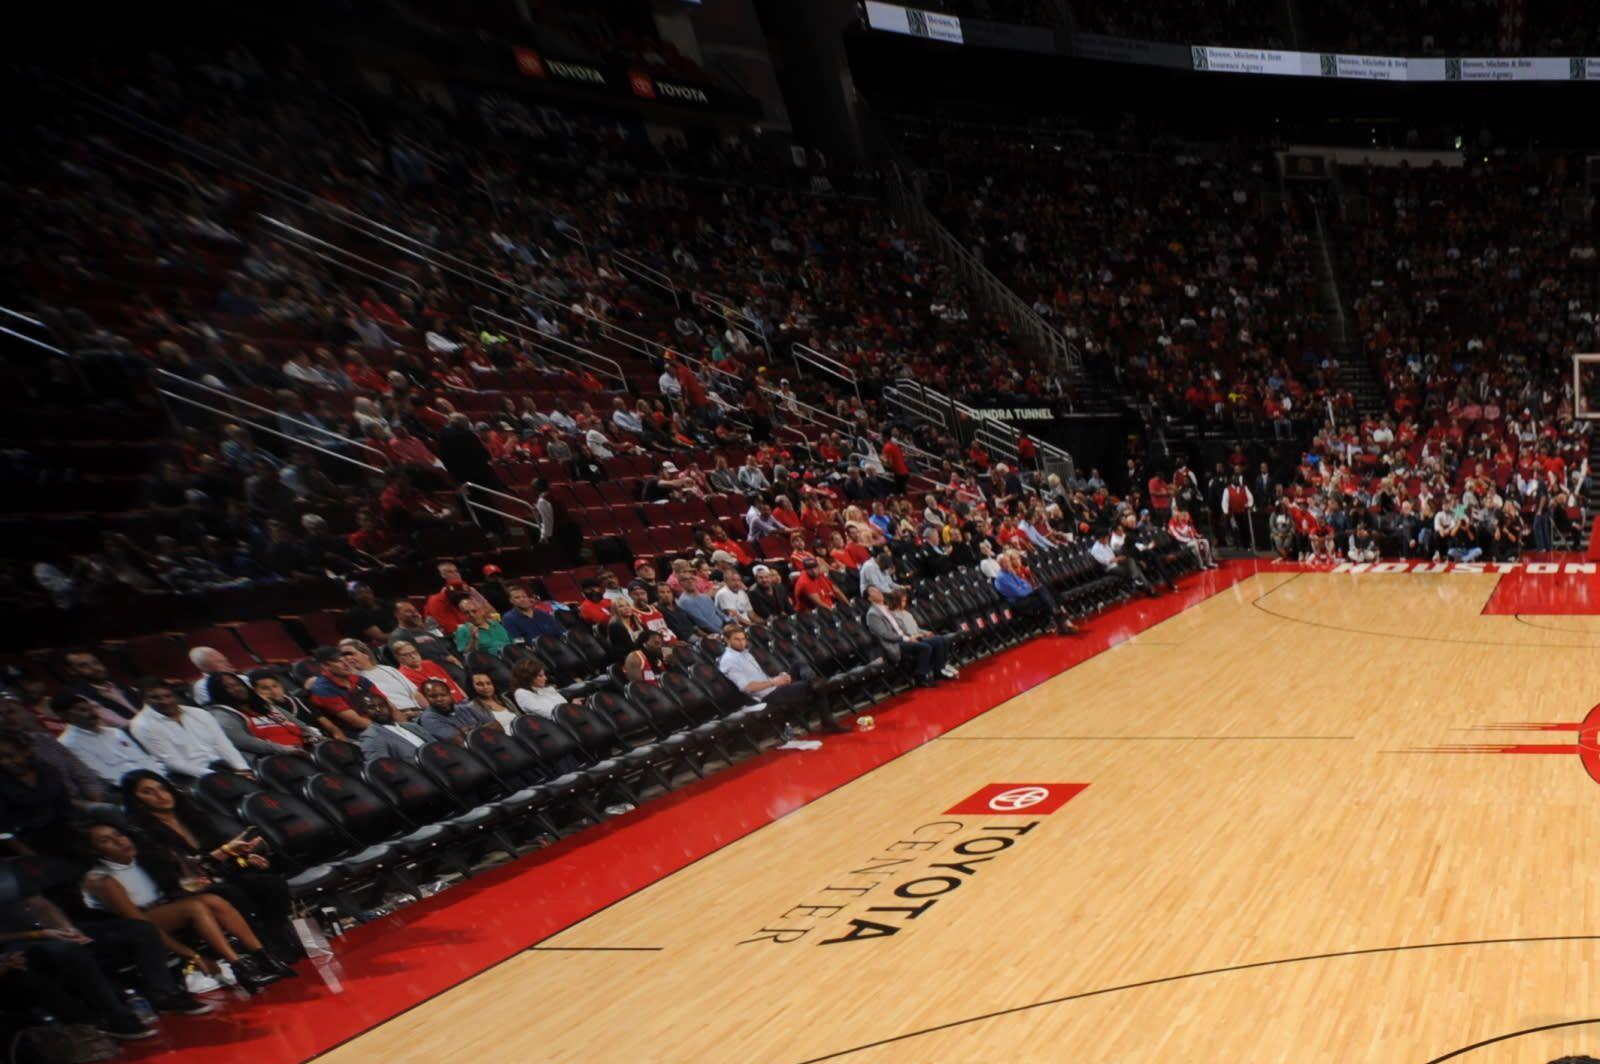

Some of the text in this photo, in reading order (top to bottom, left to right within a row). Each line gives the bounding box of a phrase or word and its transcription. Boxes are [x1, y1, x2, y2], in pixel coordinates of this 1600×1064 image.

[544, 58, 608, 88] TOYOTA
[655, 80, 711, 104] TOYOTA
[1014, 408, 1056, 420] TUNNEL
[1331, 563, 1597, 575] HOUSTON
[736, 821, 964, 946] CENTER
[816, 821, 1040, 946] TOYOTA
